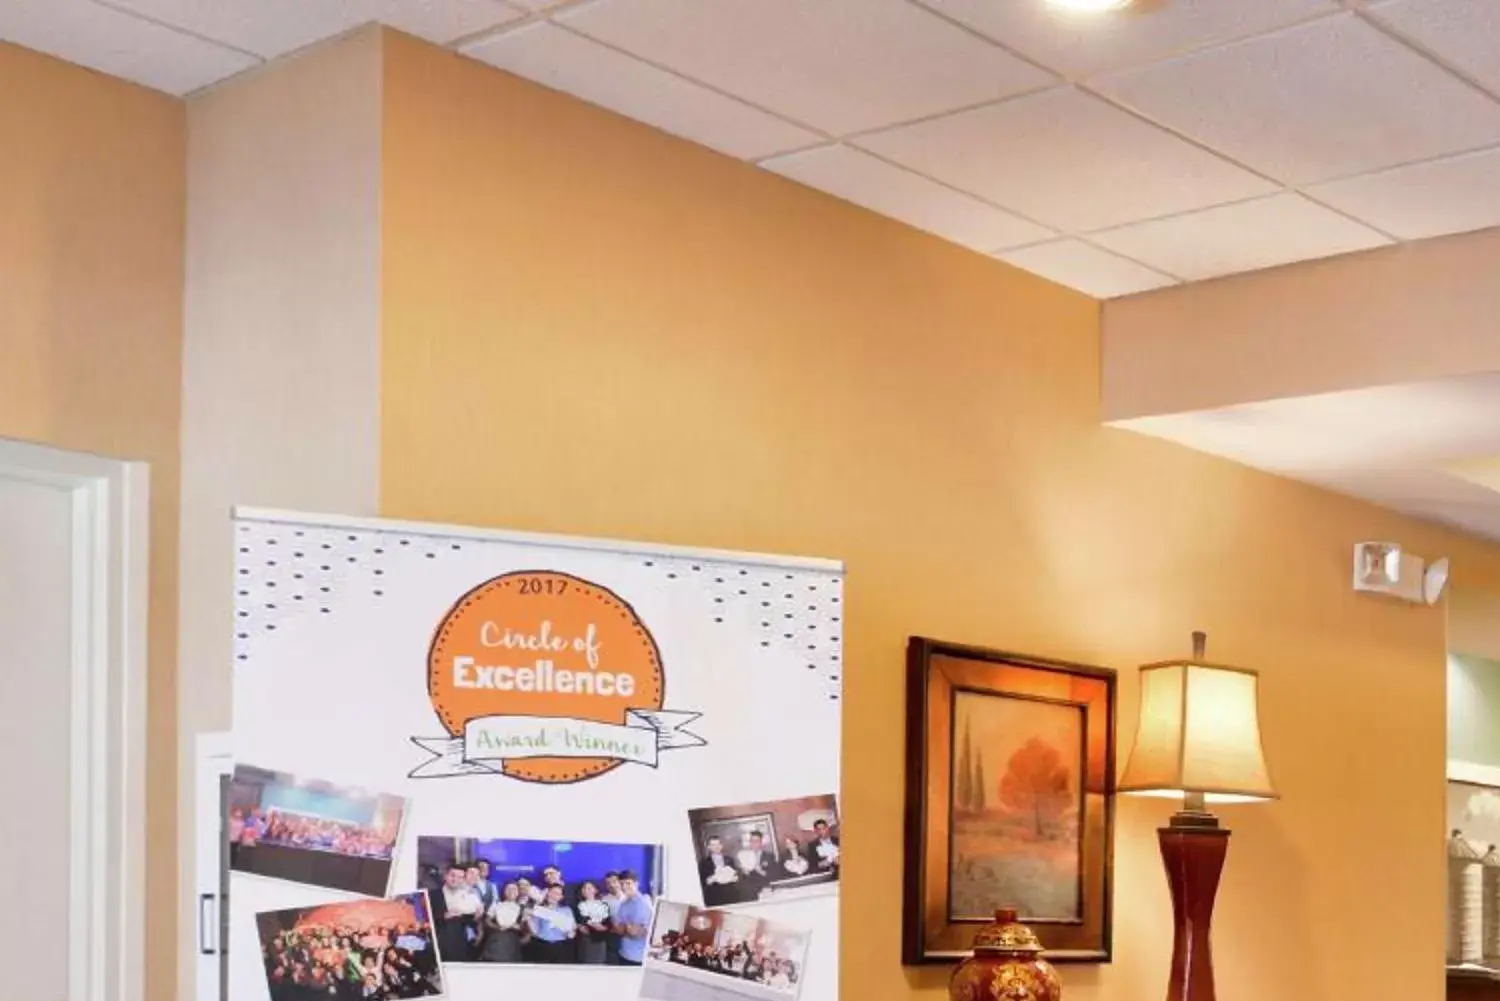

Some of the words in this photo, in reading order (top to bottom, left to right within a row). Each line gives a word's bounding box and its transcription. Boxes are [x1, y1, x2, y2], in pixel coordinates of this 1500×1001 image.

[517, 578, 569, 595] 2017
[480, 620, 568, 651] Circle
[572, 622, 604, 670] of
[452, 655, 636, 697] Excellence
[476, 728, 550, 750] Award
[556, 729, 646, 756] Winner
